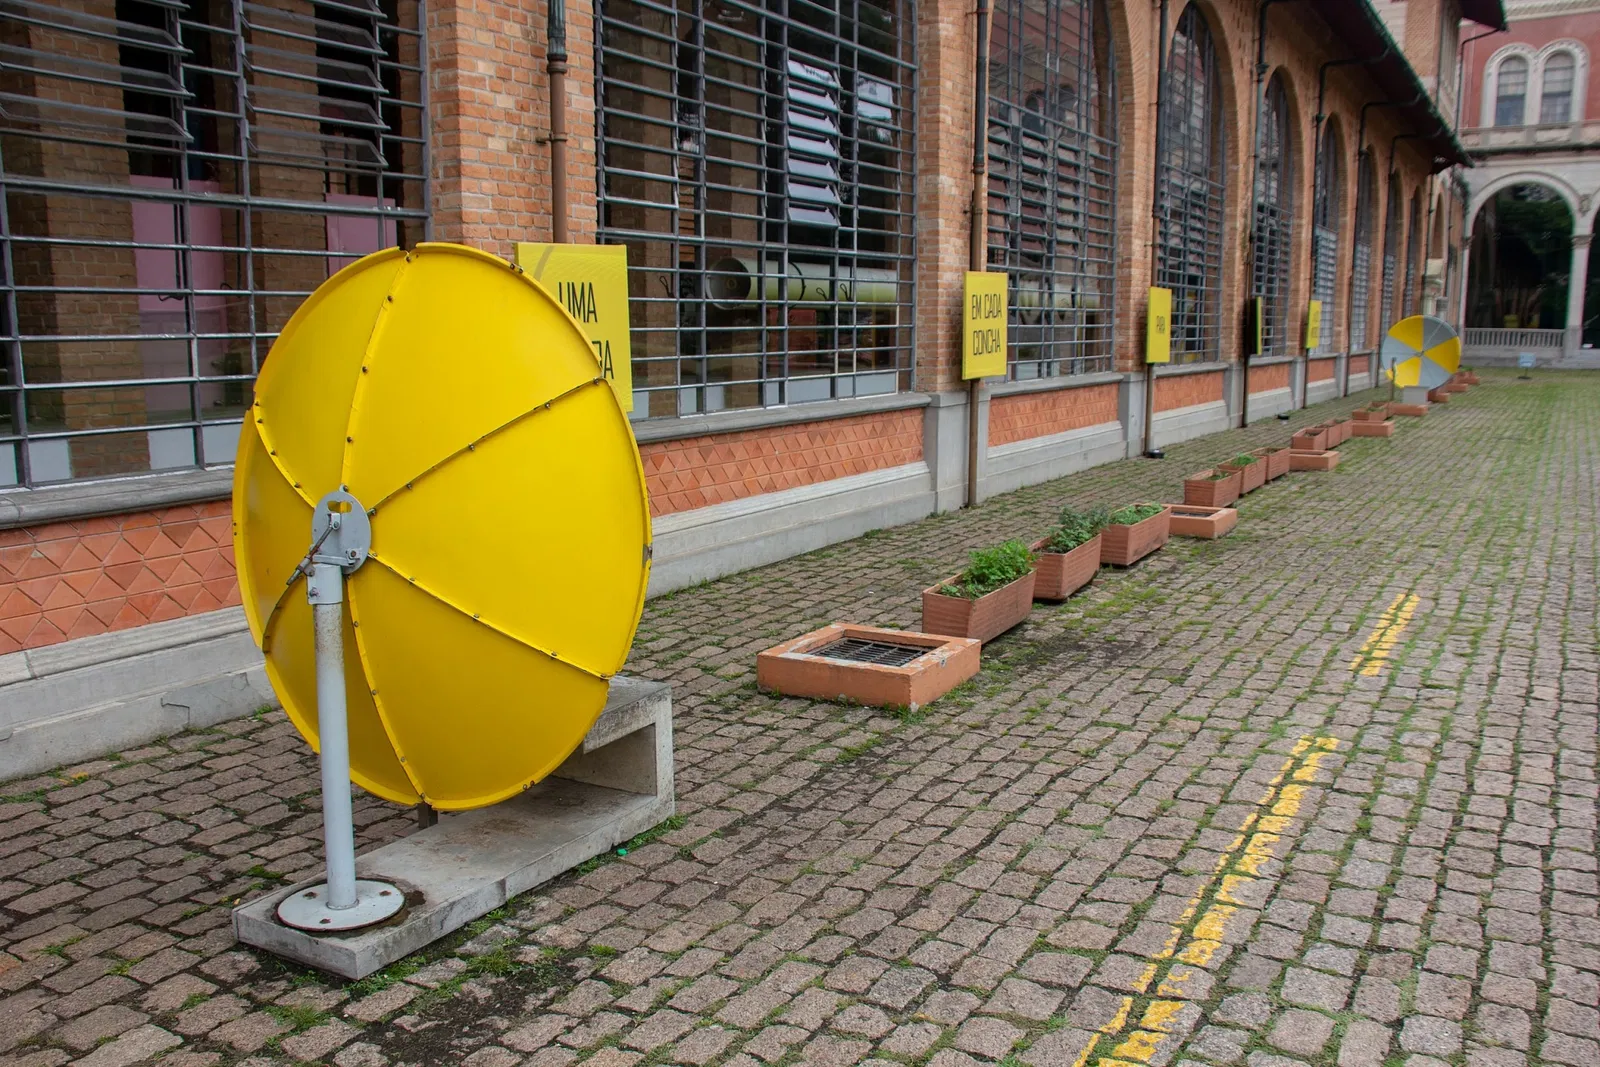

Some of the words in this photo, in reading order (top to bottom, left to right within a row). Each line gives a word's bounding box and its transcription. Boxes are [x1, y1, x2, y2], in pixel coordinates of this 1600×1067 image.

[971, 294, 982, 320] EM
[984, 293, 1003, 319] CADA
[973, 328, 1002, 356] CONCHA
